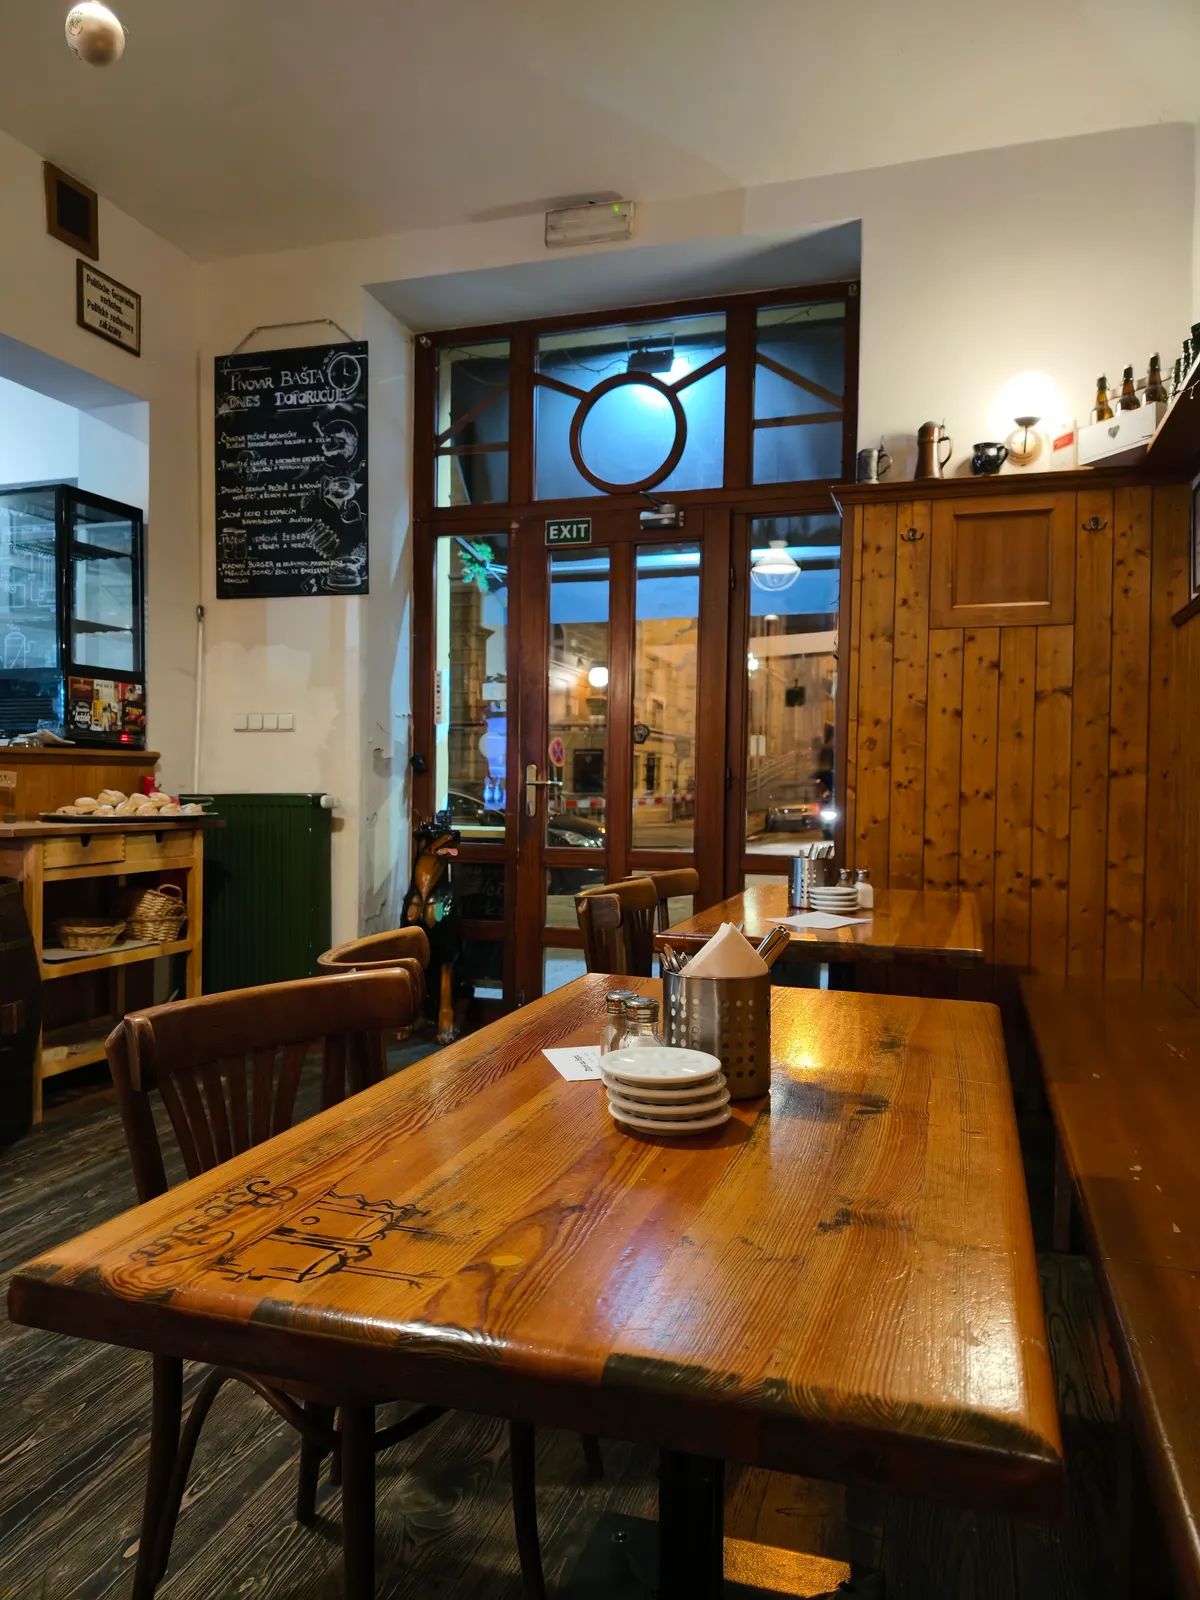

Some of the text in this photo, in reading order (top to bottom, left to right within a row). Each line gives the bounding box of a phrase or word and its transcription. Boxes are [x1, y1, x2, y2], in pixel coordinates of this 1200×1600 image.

[280, 366, 325, 387] BAŠTA
[228, 386, 346, 408] DNES DOPORUČUJE
[549, 524, 588, 540] EXIT
[248, 559, 275, 569] BURGER
